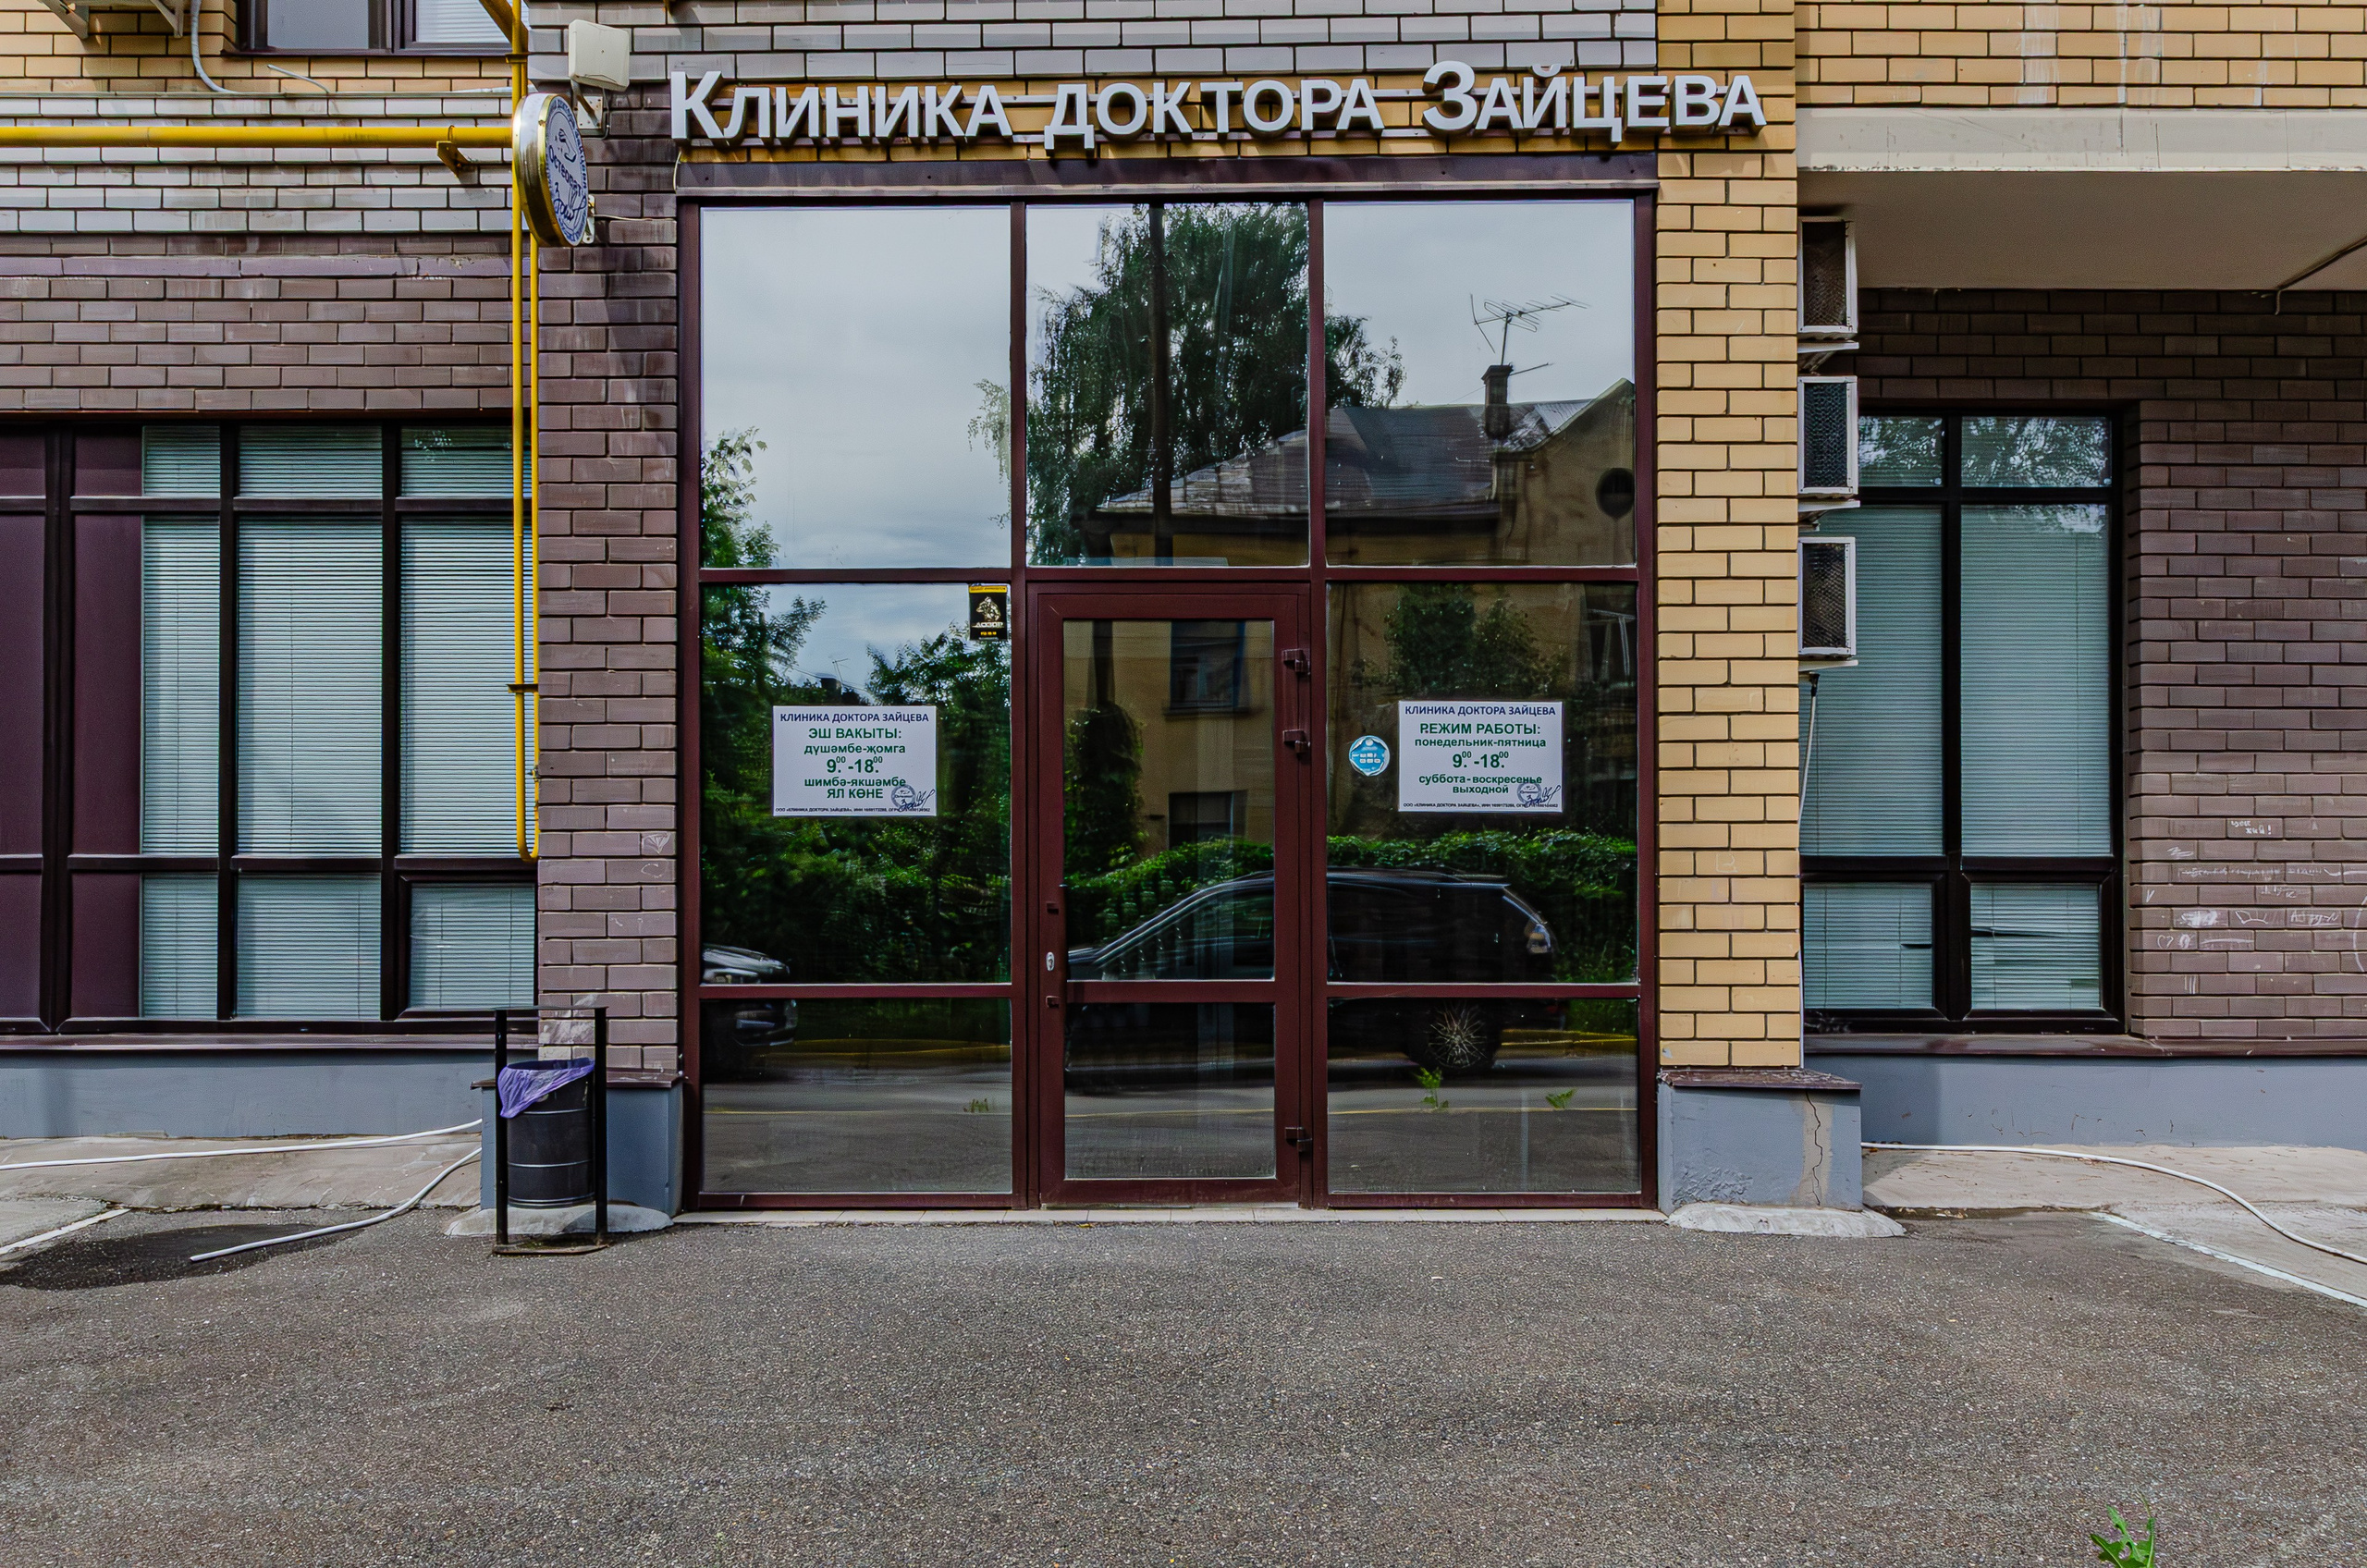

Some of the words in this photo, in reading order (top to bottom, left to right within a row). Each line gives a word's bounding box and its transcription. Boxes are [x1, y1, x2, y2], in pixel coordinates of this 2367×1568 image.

[670, 71, 1014, 141] КЛИНИКА
[1043, 80, 1384, 154] ДОКТОРА
[1422, 61, 1767, 144] ЗАЙЦЕВА
[1404, 705, 1455, 715] КЛИНИКА
[1457, 705, 1506, 717] ДОКТОРА
[1508, 704, 1556, 717] ЗАЙЦЕВА
[779, 713, 830, 722] КЛИНИКА
[832, 713, 880, 723] ДОКТОРА
[882, 712, 929, 723] ЗАЙЦЕВА
[808, 728, 831, 739] ЭШ
[835, 728, 901, 739] ВАКЫТЫ:
[1419, 723, 1472, 734] РЕЖИМ
[1476, 723, 1541, 734] РАБОТЫ:
[1415, 738, 1547, 748] понедельник-пятница
[804, 776, 906, 787] шимбә-якшәмбе
[827, 788, 845, 799] ЯЛ
[848, 788, 884, 799] КӨНЕ
[1453, 784, 1509, 794] выходной
